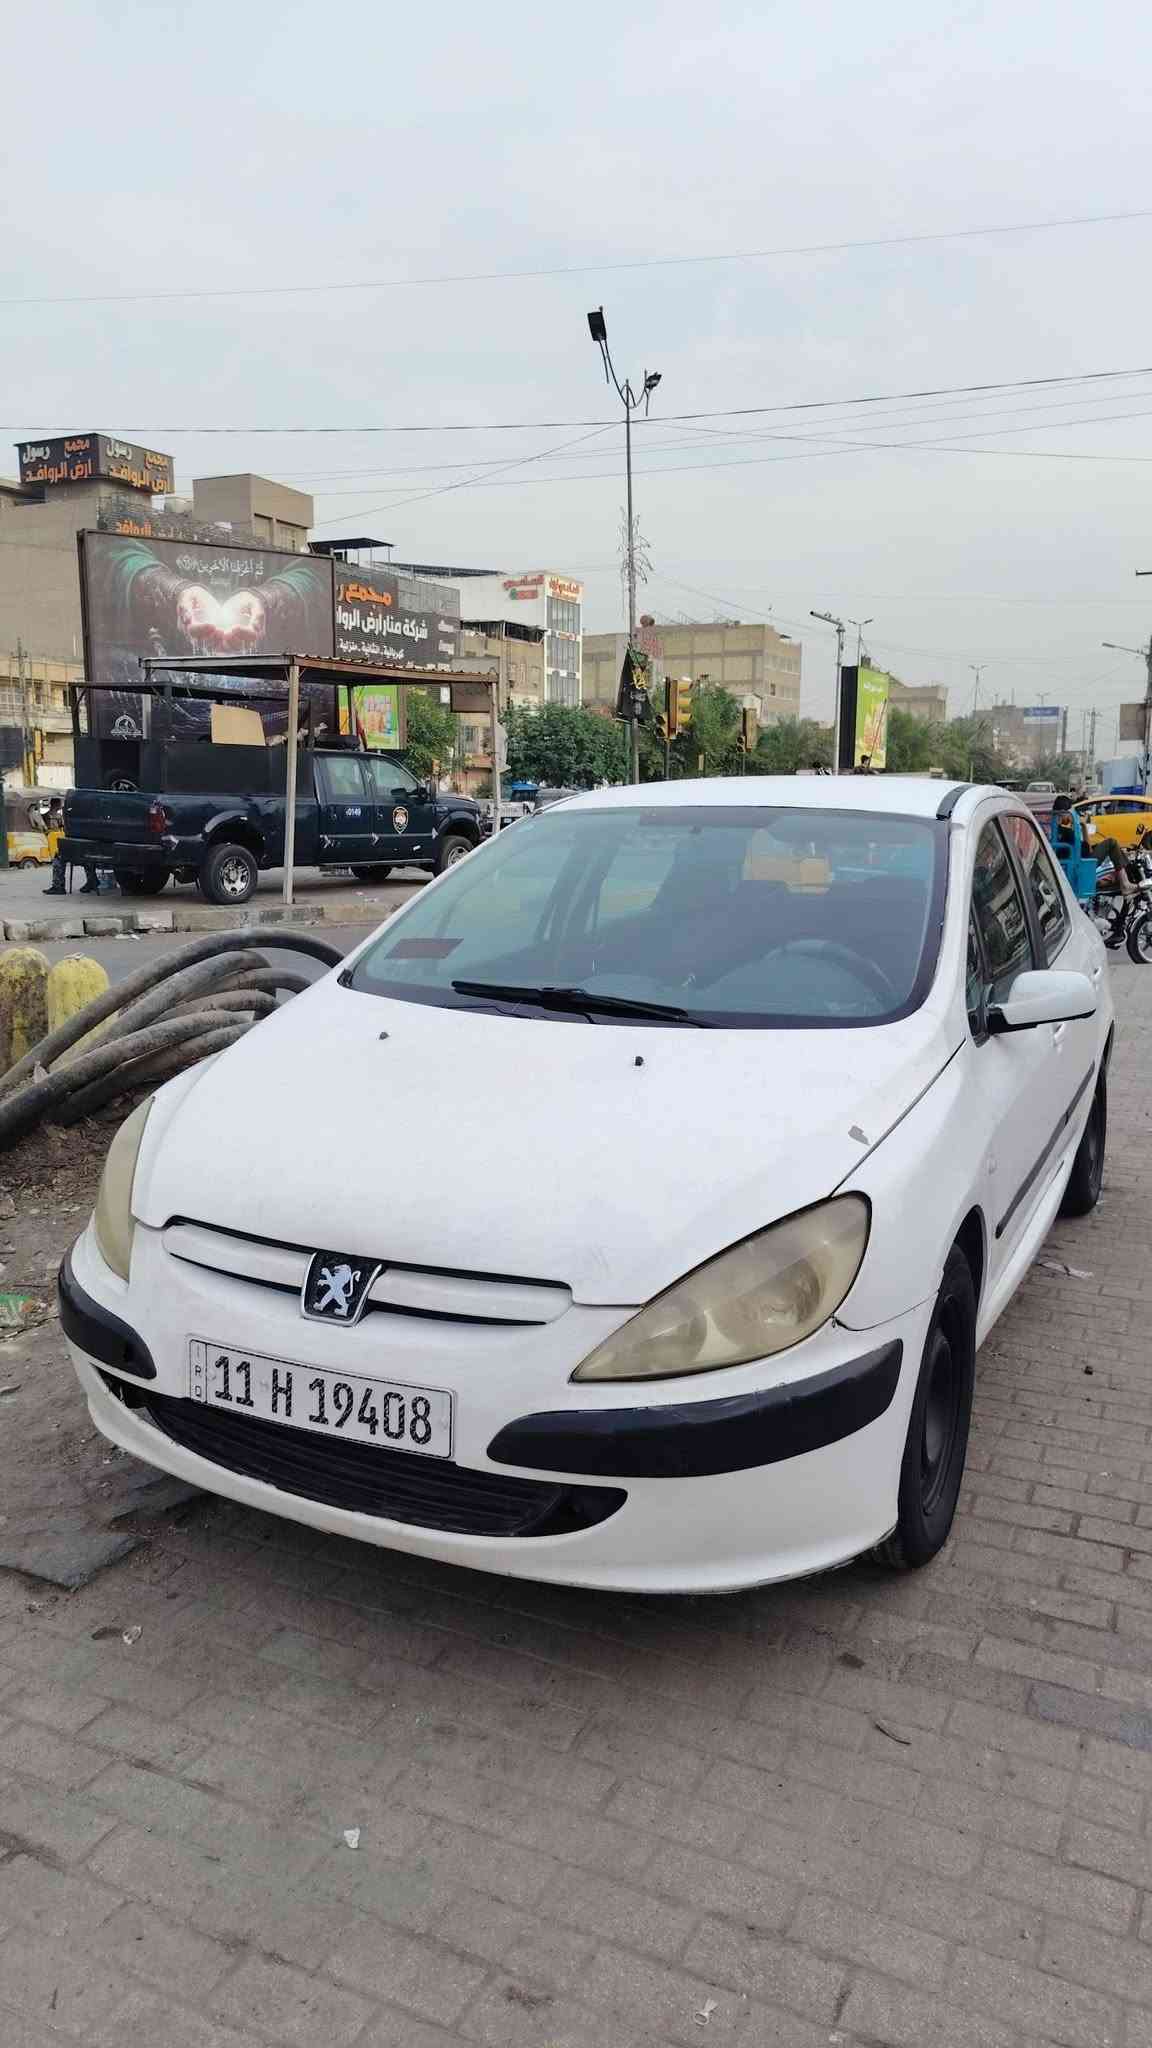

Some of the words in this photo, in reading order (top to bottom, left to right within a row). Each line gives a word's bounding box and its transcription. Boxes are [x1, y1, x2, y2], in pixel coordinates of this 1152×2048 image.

[22, 445, 51, 463] رسول
[65, 439, 91, 458] مجمع
[106, 440, 132, 460] رسول
[144, 452, 169, 471] مجمع
[345, 583, 392, 606] مجمع
[402, 617, 428, 642] شركة
[214, 1355, 254, 1408] 11
[271, 1367, 293, 1418] H
[308, 1377, 432, 1446] 19408
